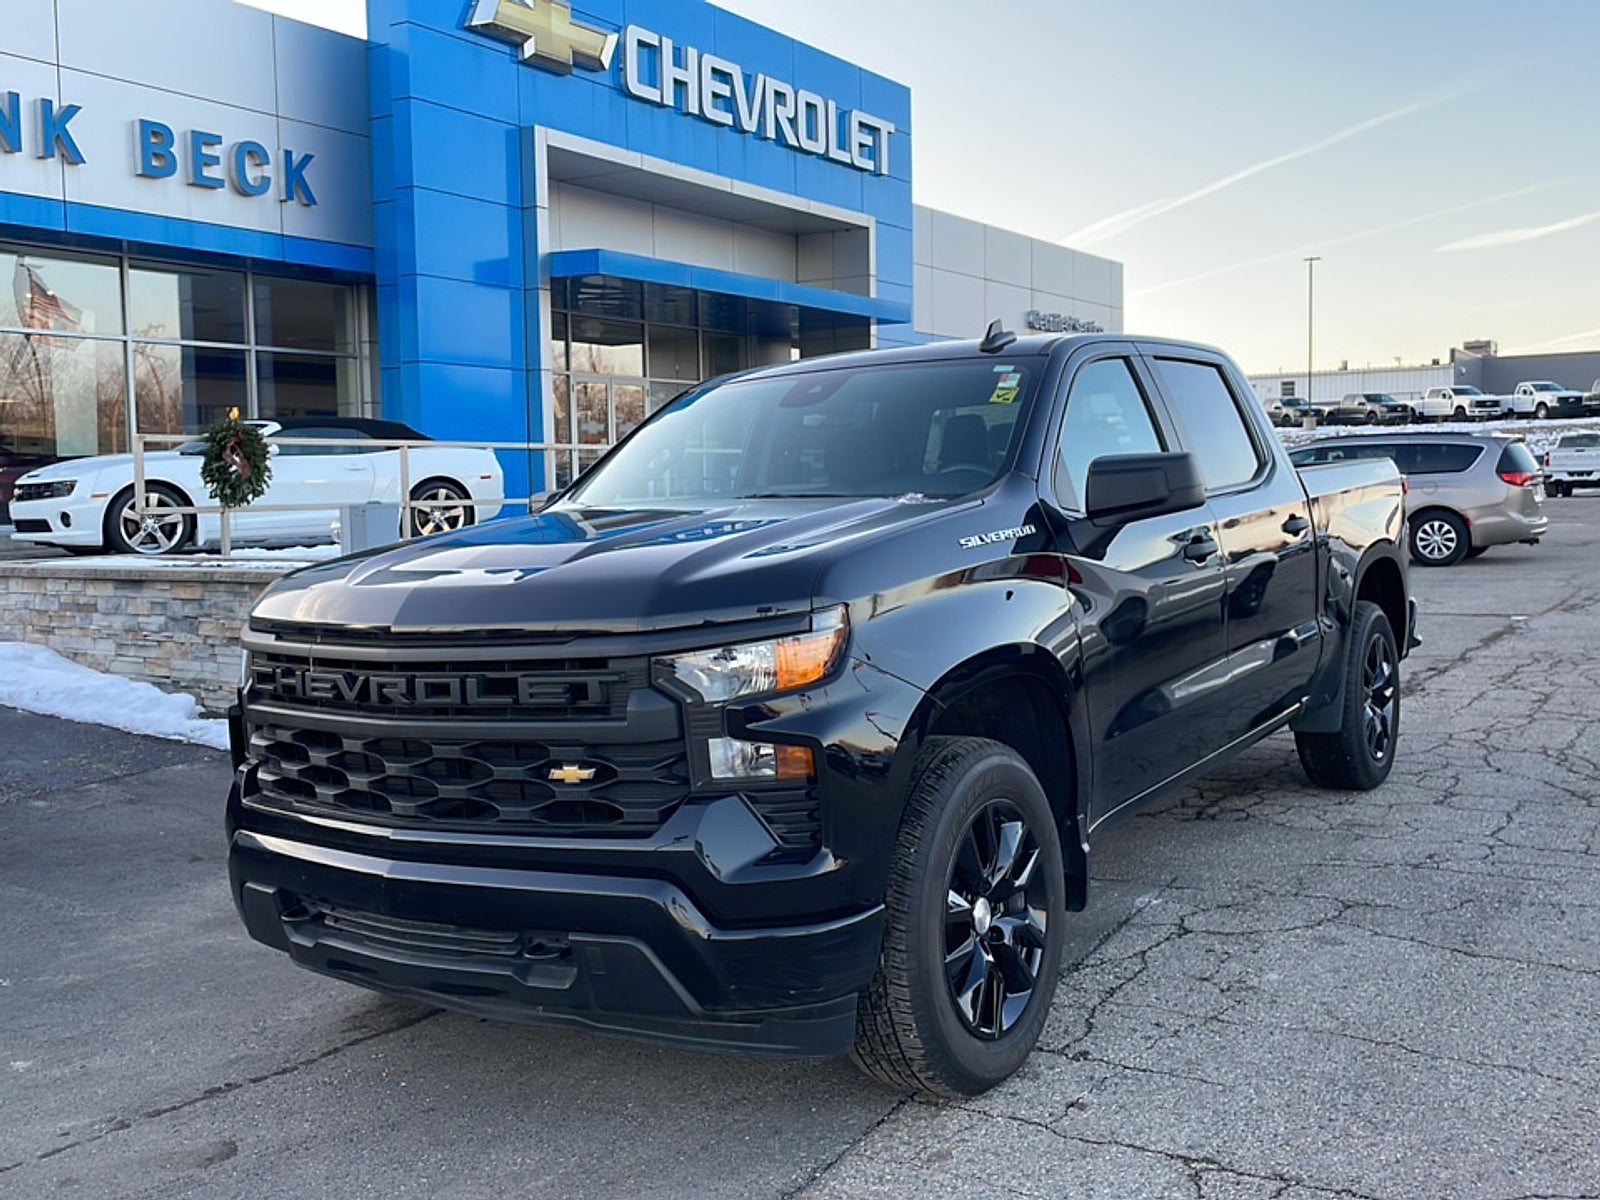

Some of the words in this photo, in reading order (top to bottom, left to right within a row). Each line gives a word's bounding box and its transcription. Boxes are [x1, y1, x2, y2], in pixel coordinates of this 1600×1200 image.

[623, 23, 895, 176] CHEVROLET
[134, 118, 319, 206] BECK
[958, 524, 1037, 550] SILVERADO
[251, 664, 627, 706] CHEVROLET
